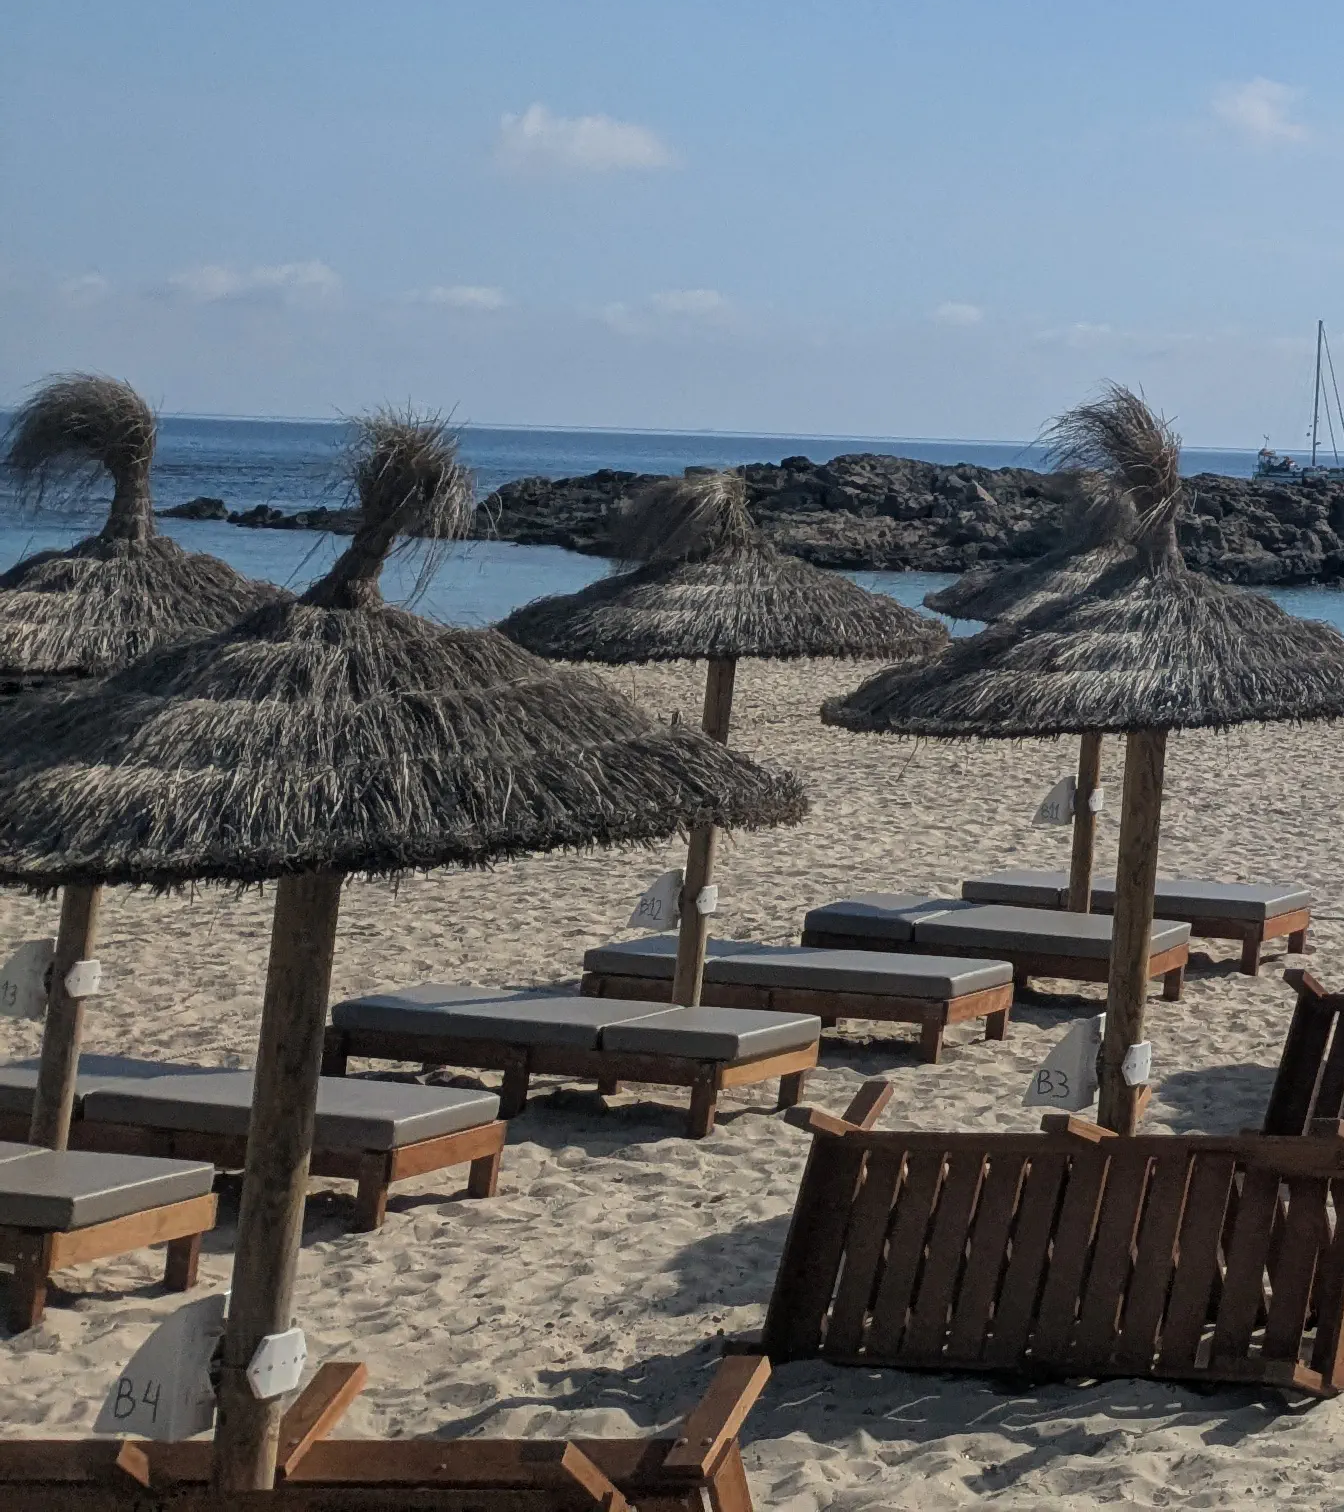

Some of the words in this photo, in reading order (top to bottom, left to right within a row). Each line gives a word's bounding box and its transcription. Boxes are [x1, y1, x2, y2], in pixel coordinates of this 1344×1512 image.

[638, 897, 663, 921] B12
[1037, 1069, 1070, 1098] B3
[113, 1377, 161, 1424] B4
